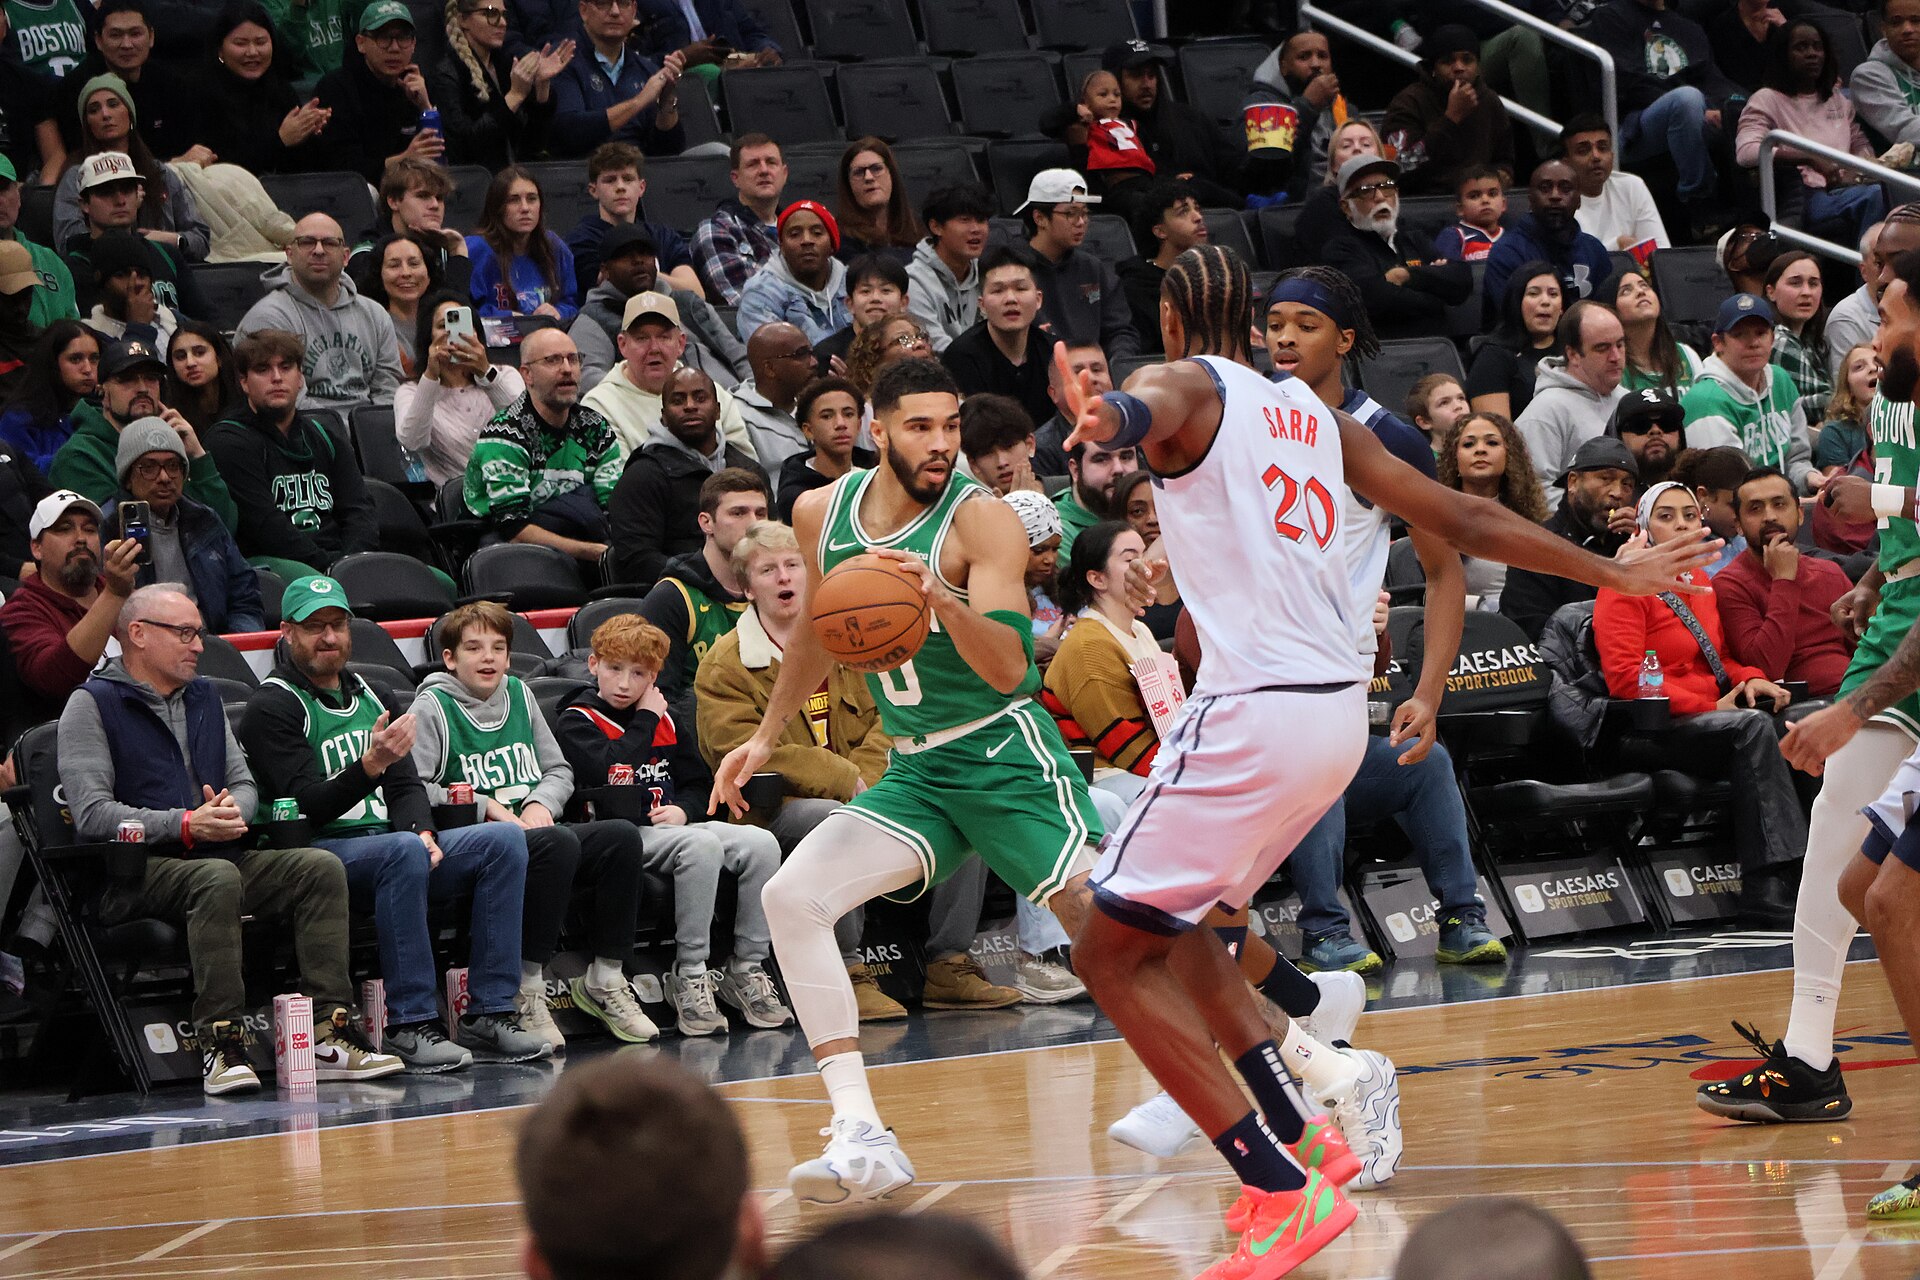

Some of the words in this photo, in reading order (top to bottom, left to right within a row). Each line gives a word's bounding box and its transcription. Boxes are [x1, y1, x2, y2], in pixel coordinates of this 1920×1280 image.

[17, 21, 86, 62] BOSTON
[303, 332, 372, 379] BINGHAM
[1262, 406, 1318, 448] SARR
[1871, 391, 1916, 450] OSTON
[1261, 463, 1339, 553] 20
[1874, 457, 1893, 530] 7
[1448, 643, 1544, 676] AESARS
[1446, 667, 1537, 693] SPORTSBOOK
[321, 729, 373, 778] CELTI
[459, 742, 543, 791] BOSTON
[118, 828, 144, 843] ke
[1541, 872, 1619, 897] CAESARS
[1691, 863, 1742, 883] CAES
[1696, 879, 1743, 895] SPORTSB
[1547, 890, 1613, 911] SPORTSBOOK
[855, 944, 902, 964] SARS
[968, 935, 1020, 955] CAES
